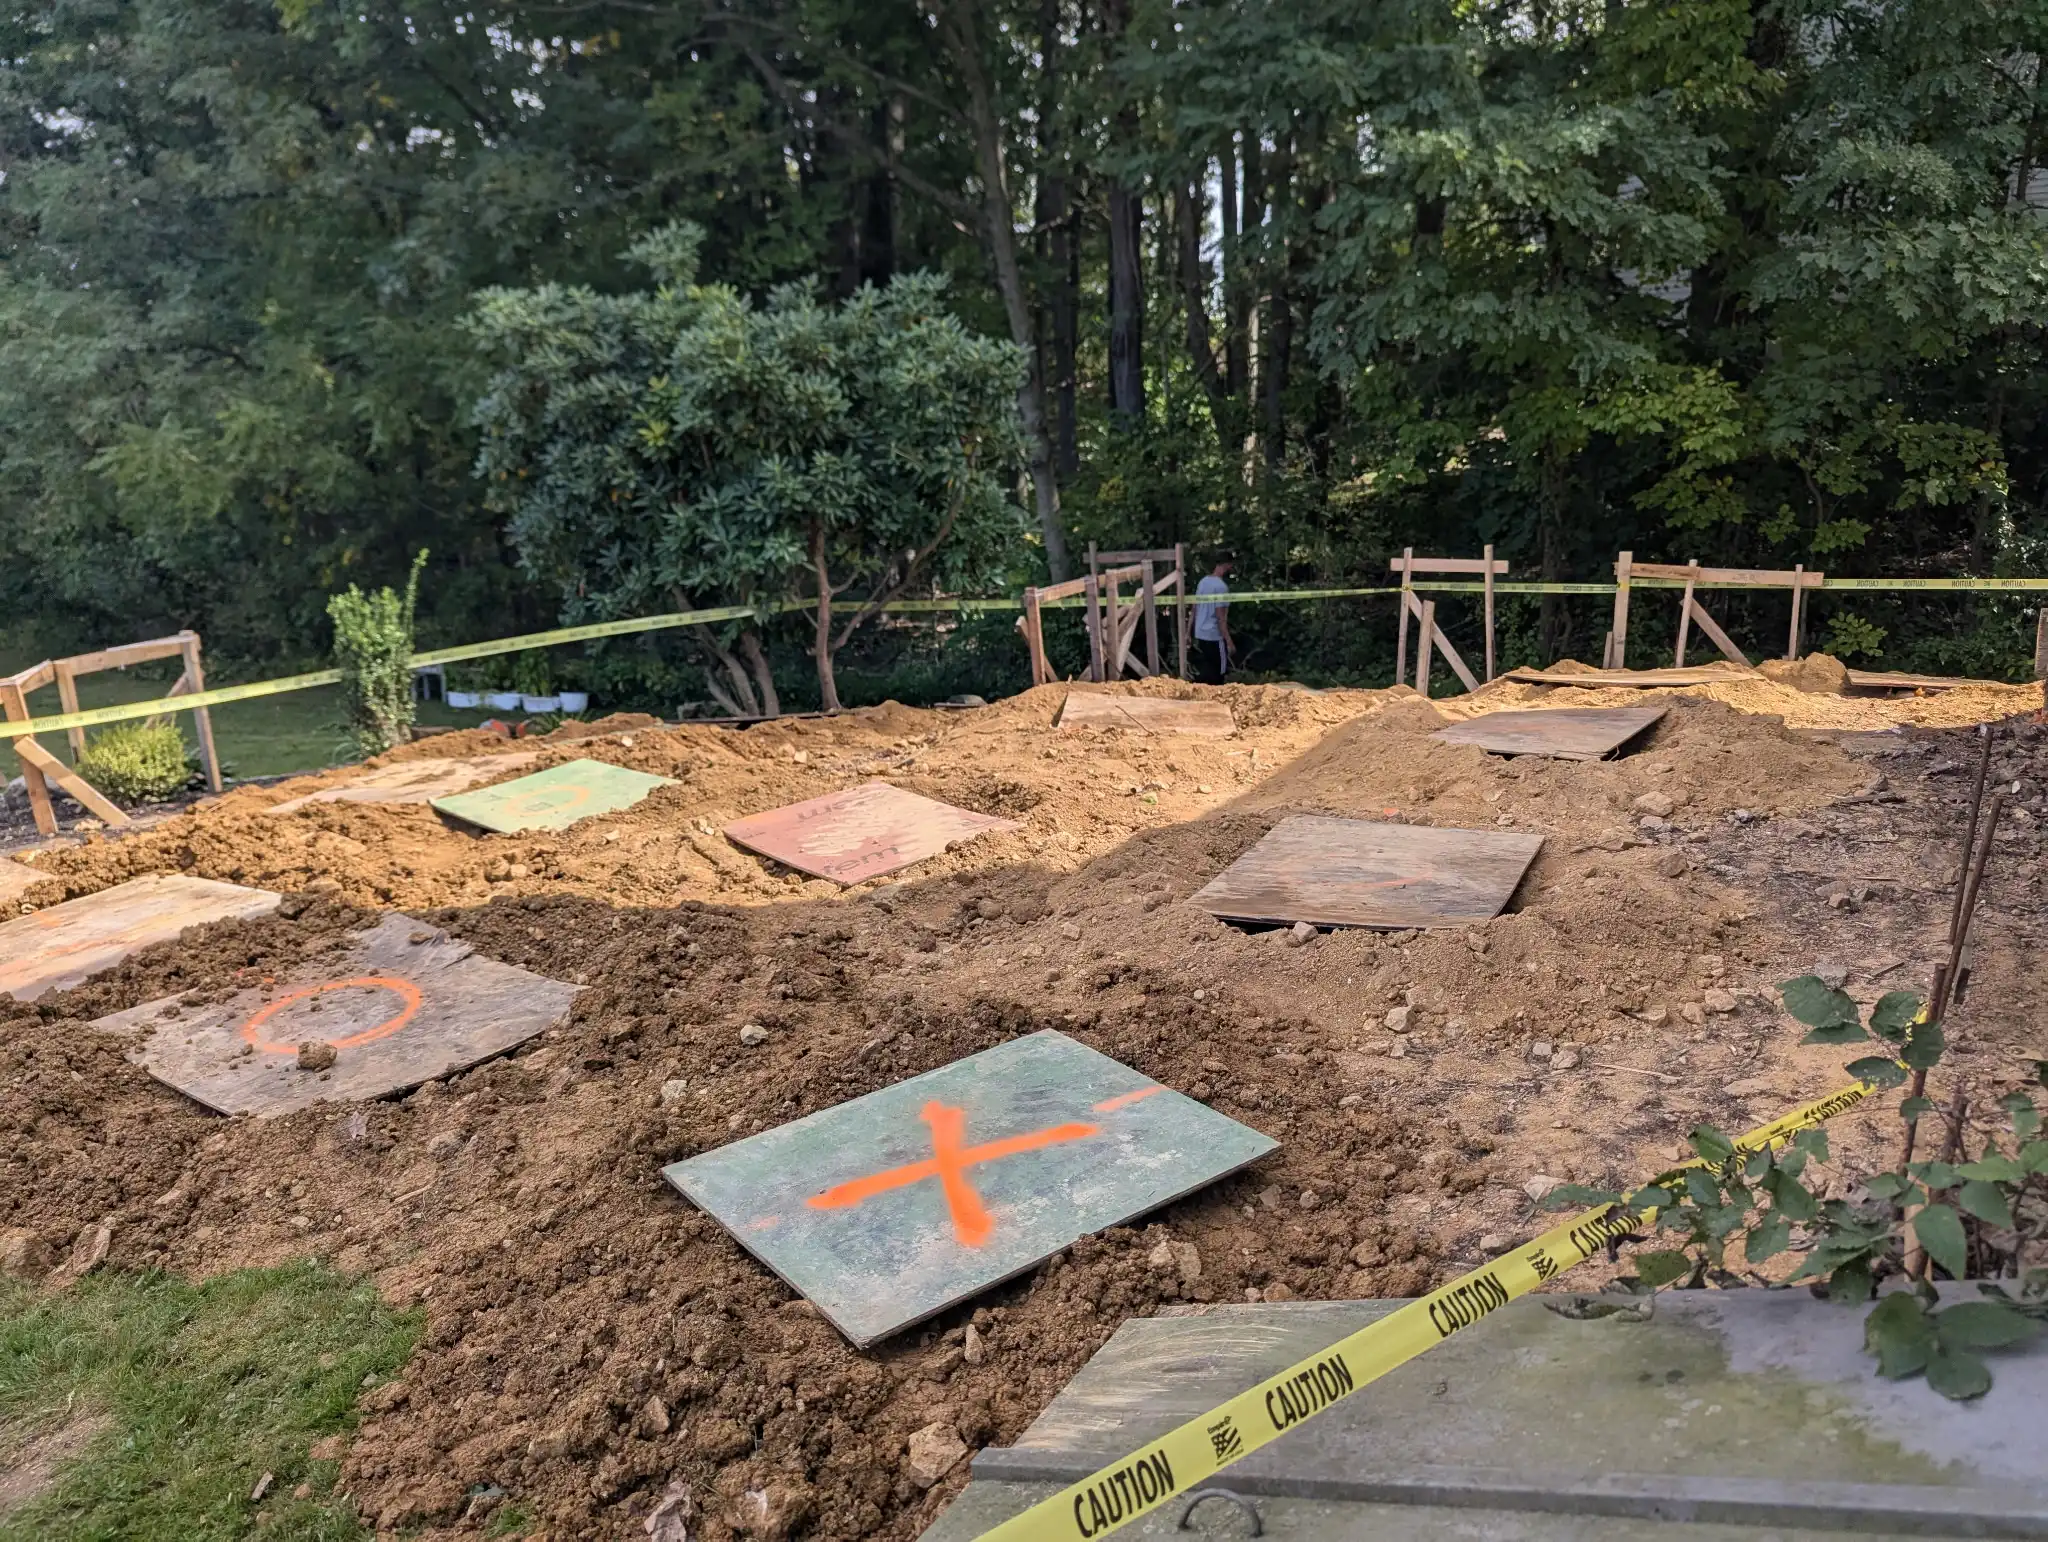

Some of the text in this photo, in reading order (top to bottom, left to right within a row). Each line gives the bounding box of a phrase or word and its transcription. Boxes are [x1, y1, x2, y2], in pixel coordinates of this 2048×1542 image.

[1074, 1449, 1175, 1538] CAUTION
[1265, 1354, 1354, 1431] CAUTION
[1429, 1272, 1509, 1338] CAUTION
